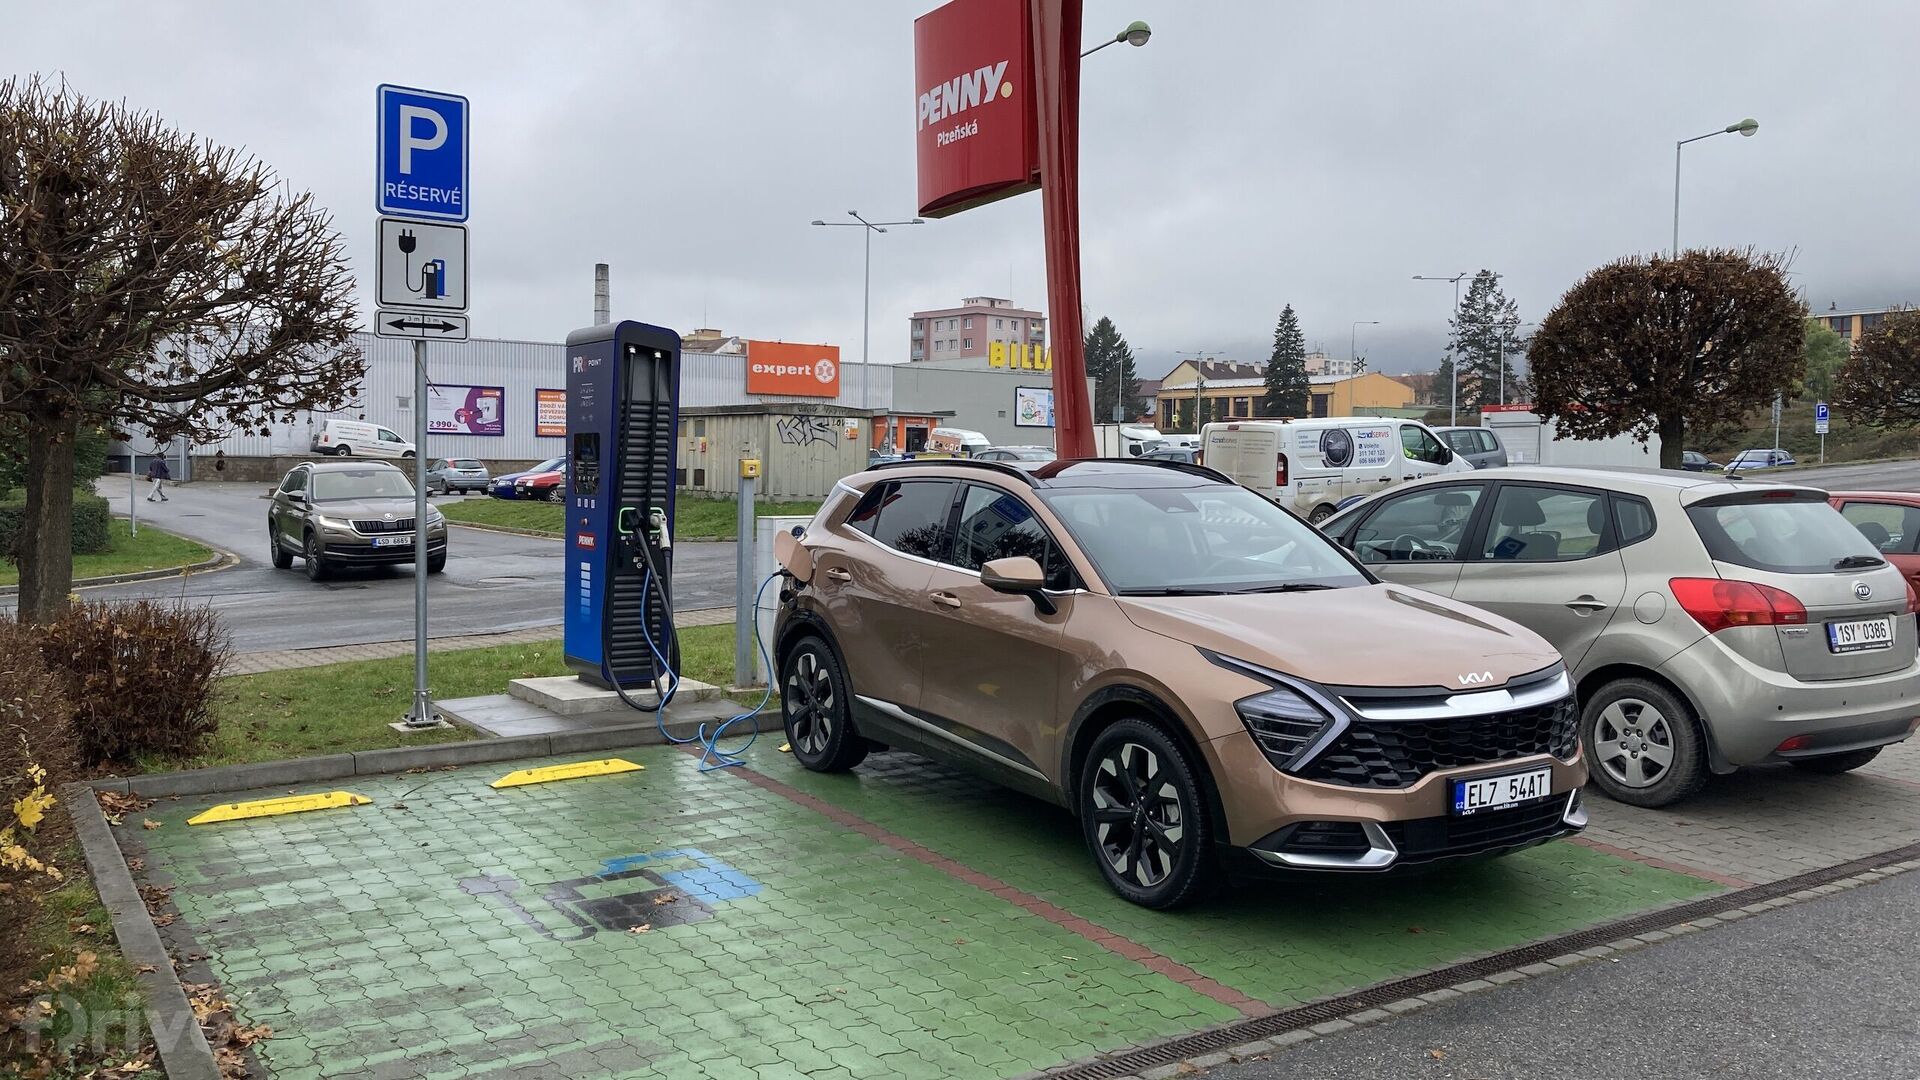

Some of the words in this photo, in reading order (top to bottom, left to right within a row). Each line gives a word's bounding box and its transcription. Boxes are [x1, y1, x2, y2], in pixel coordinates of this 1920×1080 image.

[399, 104, 448, 175] P
[937, 118, 978, 148] Plzeňská
[385, 180, 461, 206] RÉSERVÉ
[752, 363, 812, 377] expert
[1819, 406, 1827, 417] P
[437, 420, 452, 428] 990
[1857, 586, 1870, 595] KIA
[1838, 624, 1856, 643] 1SY
[1863, 621, 1887, 640] 0386
[1458, 671, 1494, 685] KIA
[1456, 801, 1464, 809] CZ
[1468, 782, 1498, 807] EL7
[1509, 774, 1545, 800] 54AT
